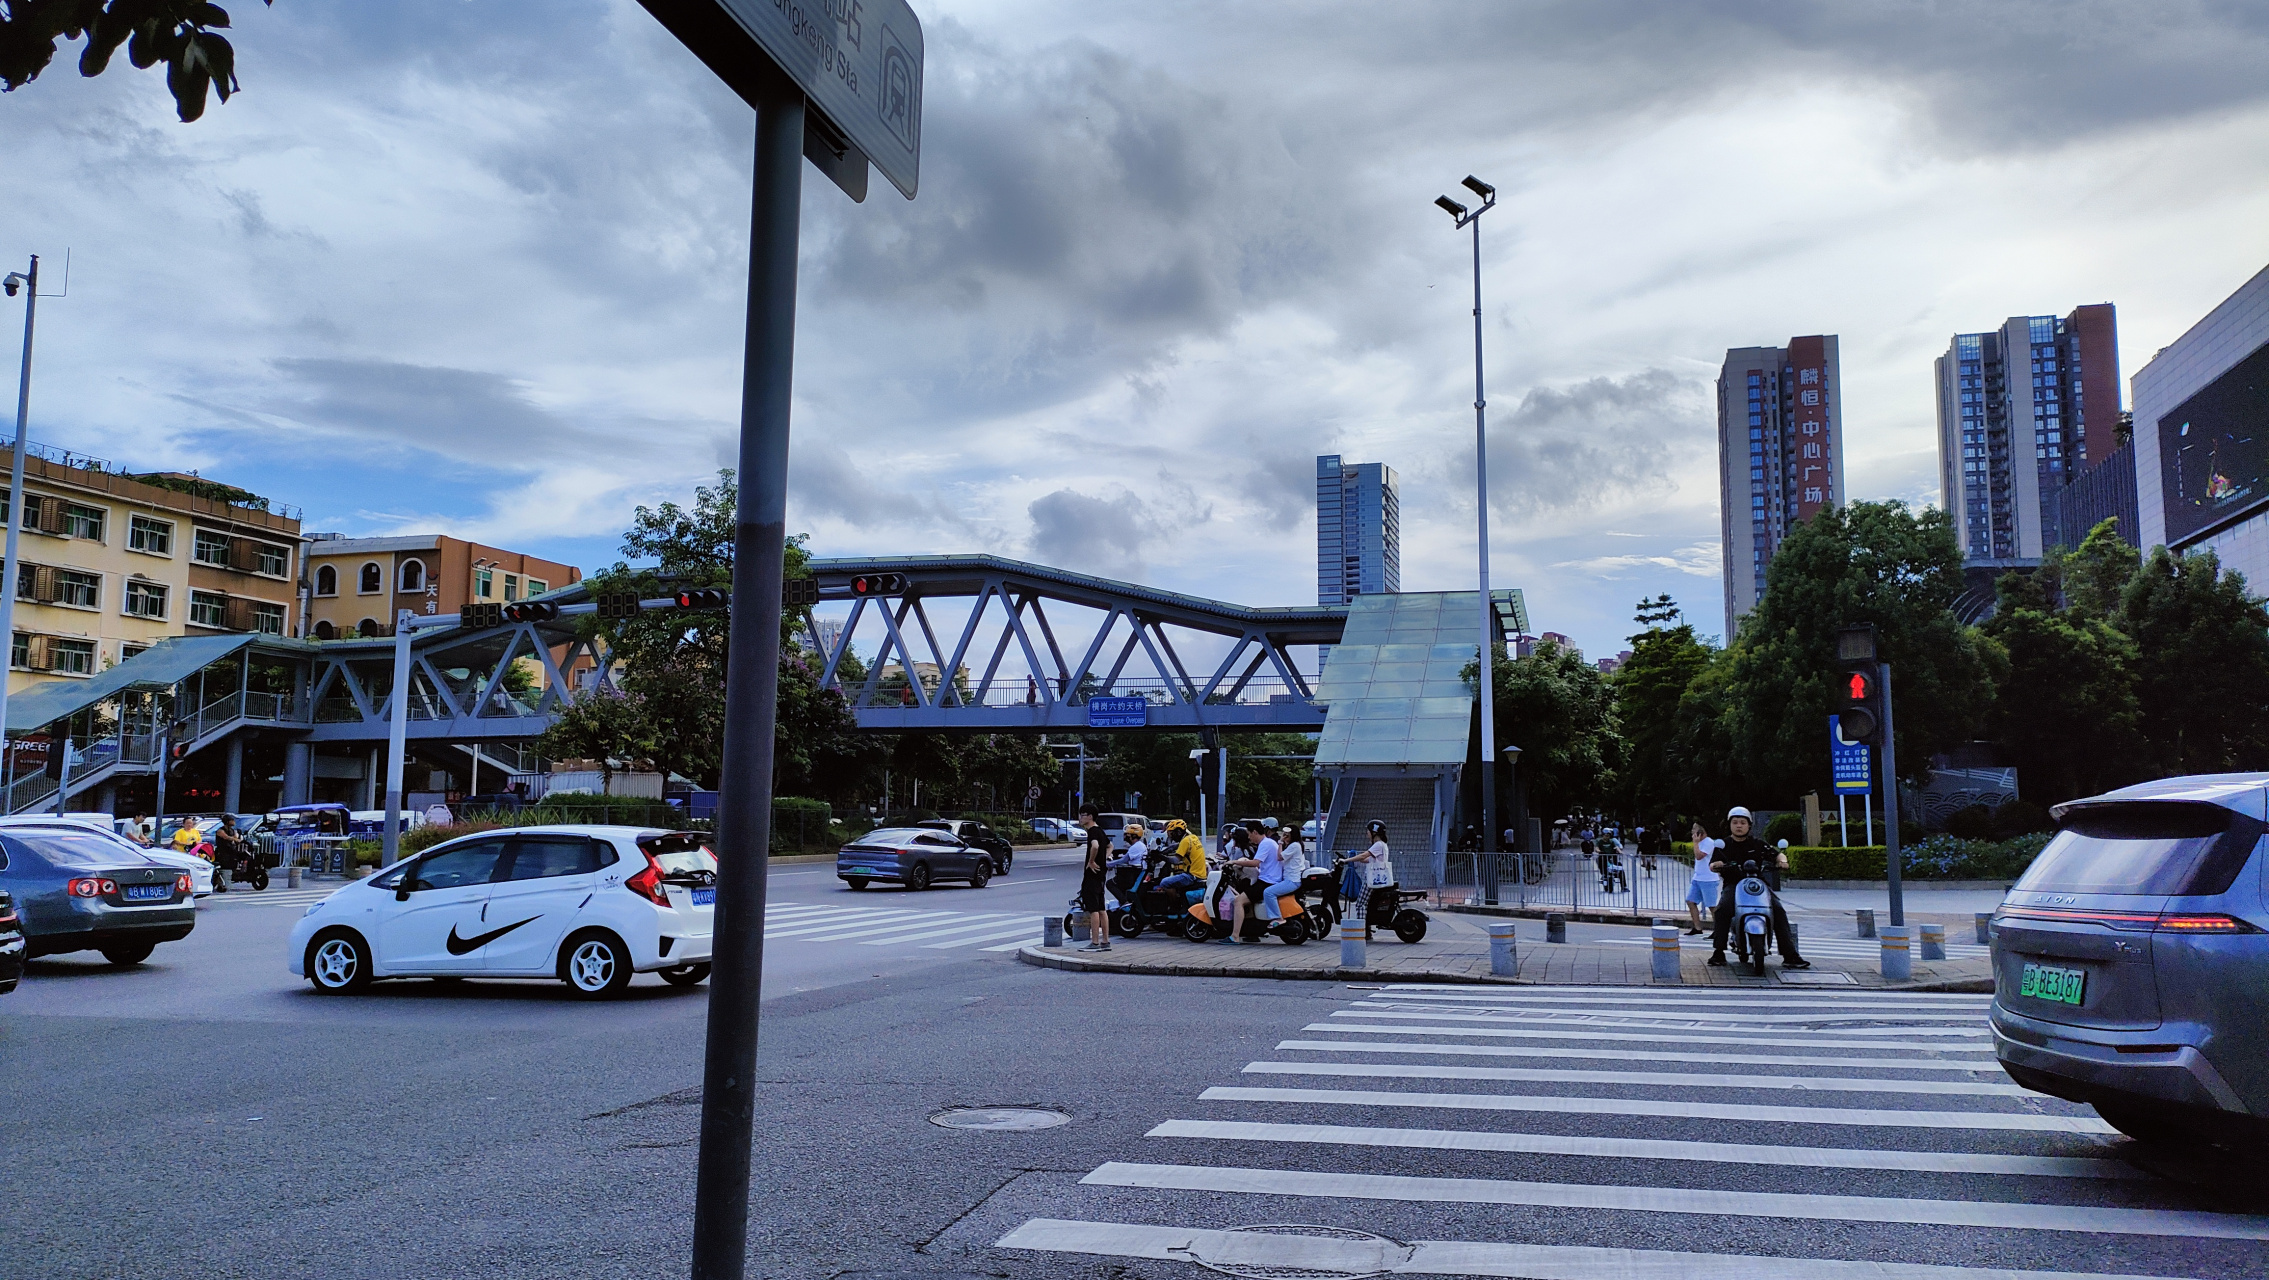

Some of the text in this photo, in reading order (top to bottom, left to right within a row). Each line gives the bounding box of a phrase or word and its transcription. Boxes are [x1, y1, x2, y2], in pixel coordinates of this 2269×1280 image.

[837, 49, 861, 98] Sta.
[1091, 701, 1143, 712] 横岗六约天桥
[14, 739, 47, 752] GREE
[2034, 895, 2076, 905] AION
